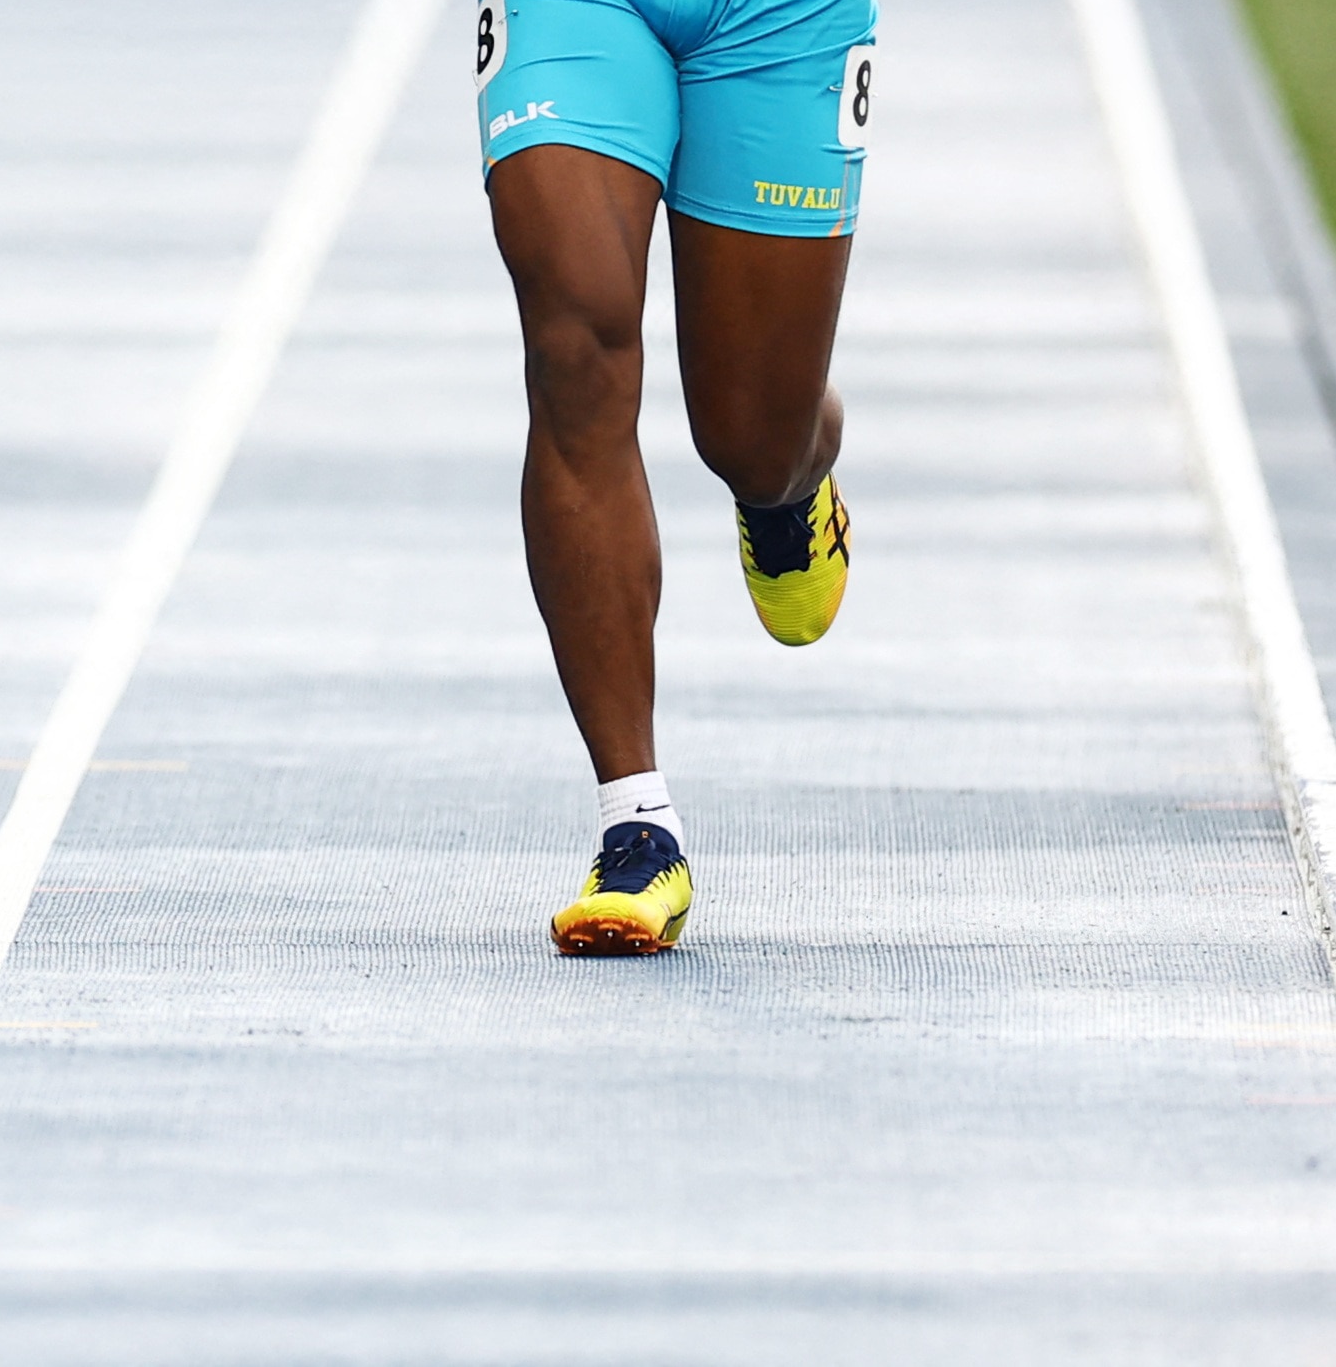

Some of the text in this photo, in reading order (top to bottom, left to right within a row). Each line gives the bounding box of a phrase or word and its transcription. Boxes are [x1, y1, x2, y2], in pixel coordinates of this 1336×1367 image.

[477, 6, 495, 76] 8
[489, 100, 561, 141] BLK
[852, 59, 872, 128] 8
[753, 180, 841, 210] TUVALU
